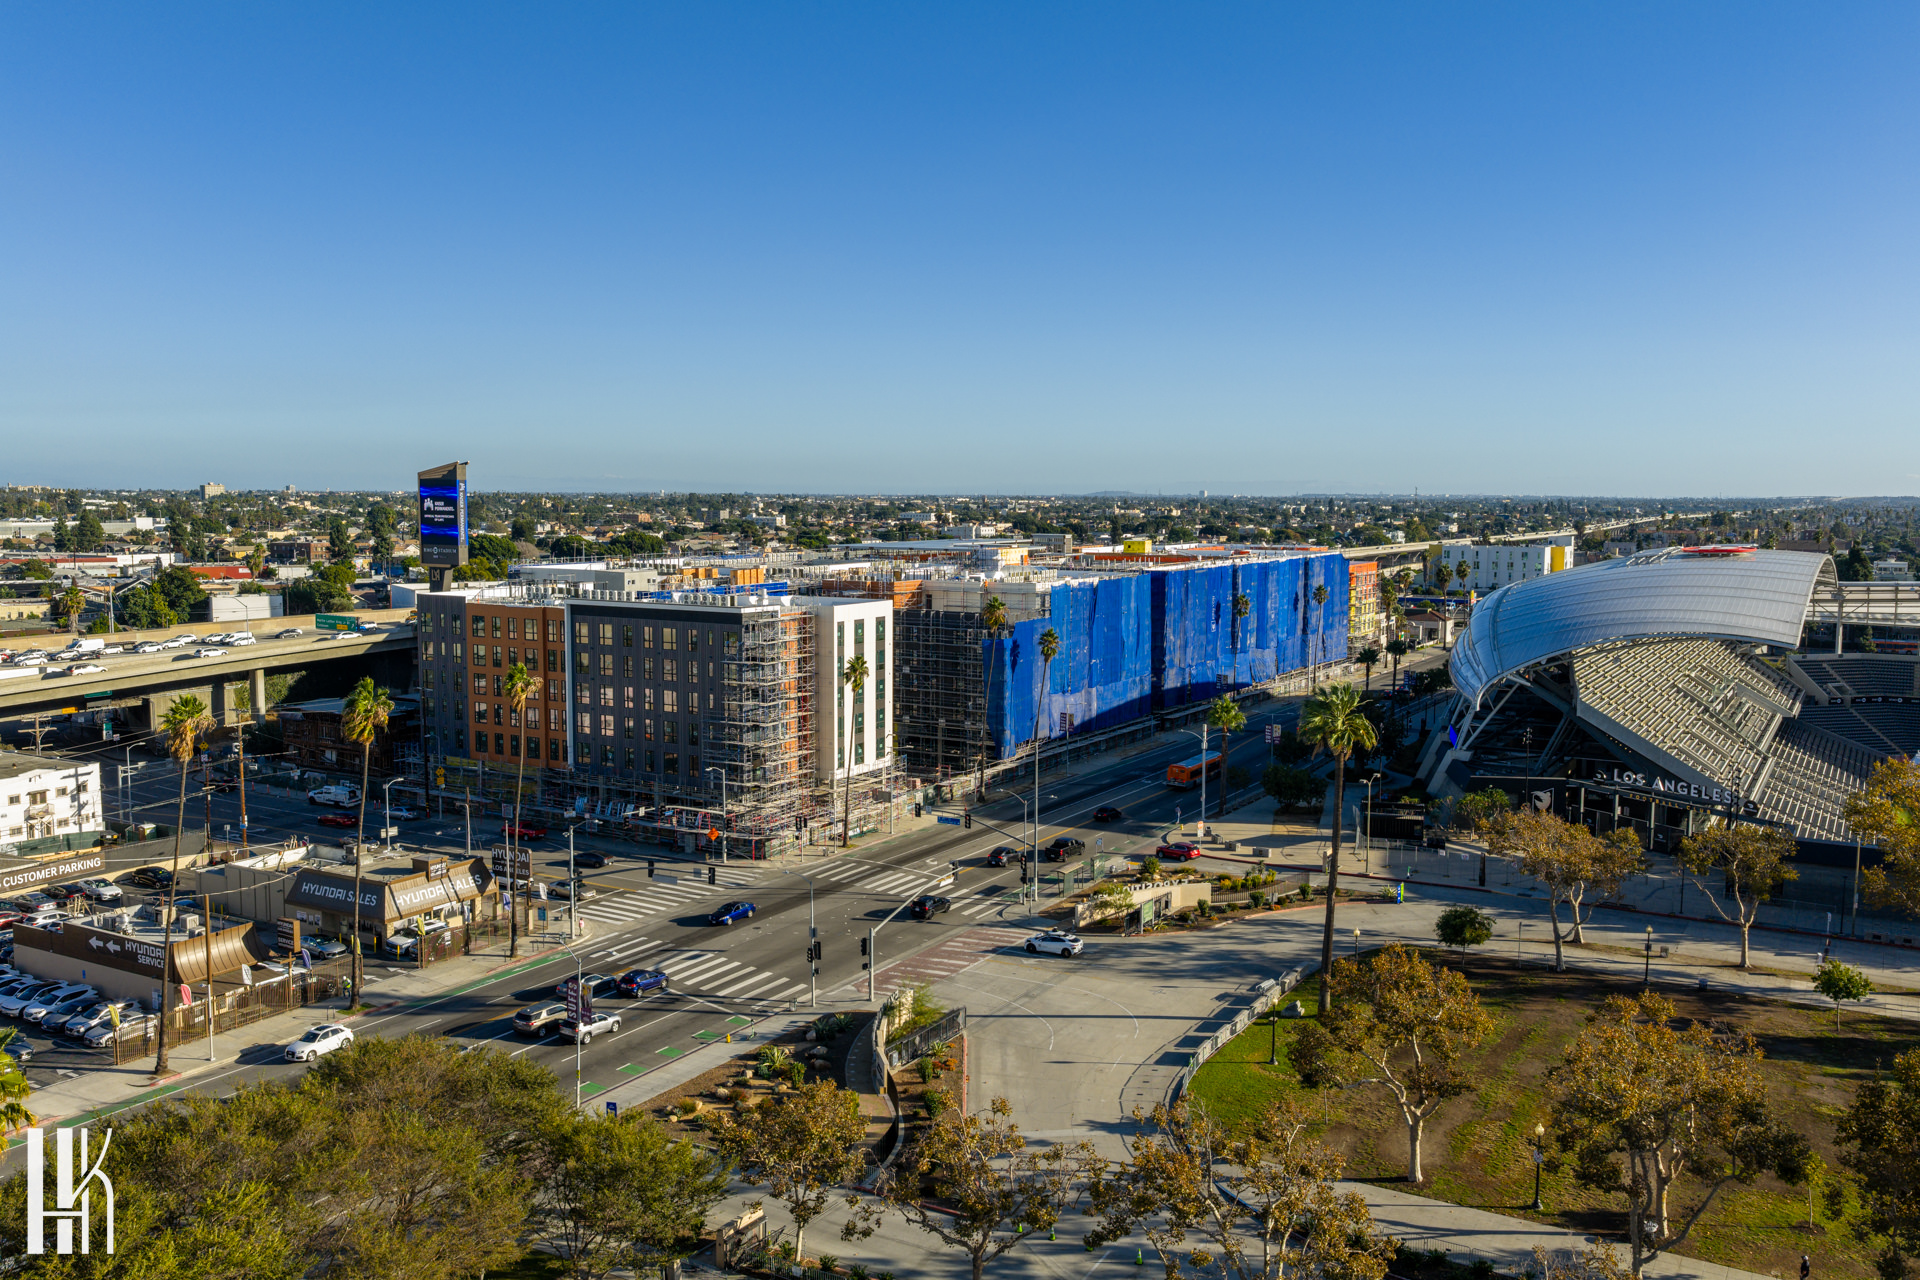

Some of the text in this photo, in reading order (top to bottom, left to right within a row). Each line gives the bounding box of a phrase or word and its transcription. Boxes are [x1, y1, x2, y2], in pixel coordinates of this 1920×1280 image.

[1613, 768, 1732, 804] LOS ANGELES
[1629, 794, 1712, 815] FOOTBALL CLUB
[3, 857, 101, 888] CUSTOMER PARKING
[302, 882, 377, 906] HYUNDAI SLES
[396, 874, 482, 906] HYUNDAI SALES
[125, 940, 165, 960] HYUNDAI
[138, 954, 165, 968] SERVICE
[568, 982, 577, 1018] SUFFS
